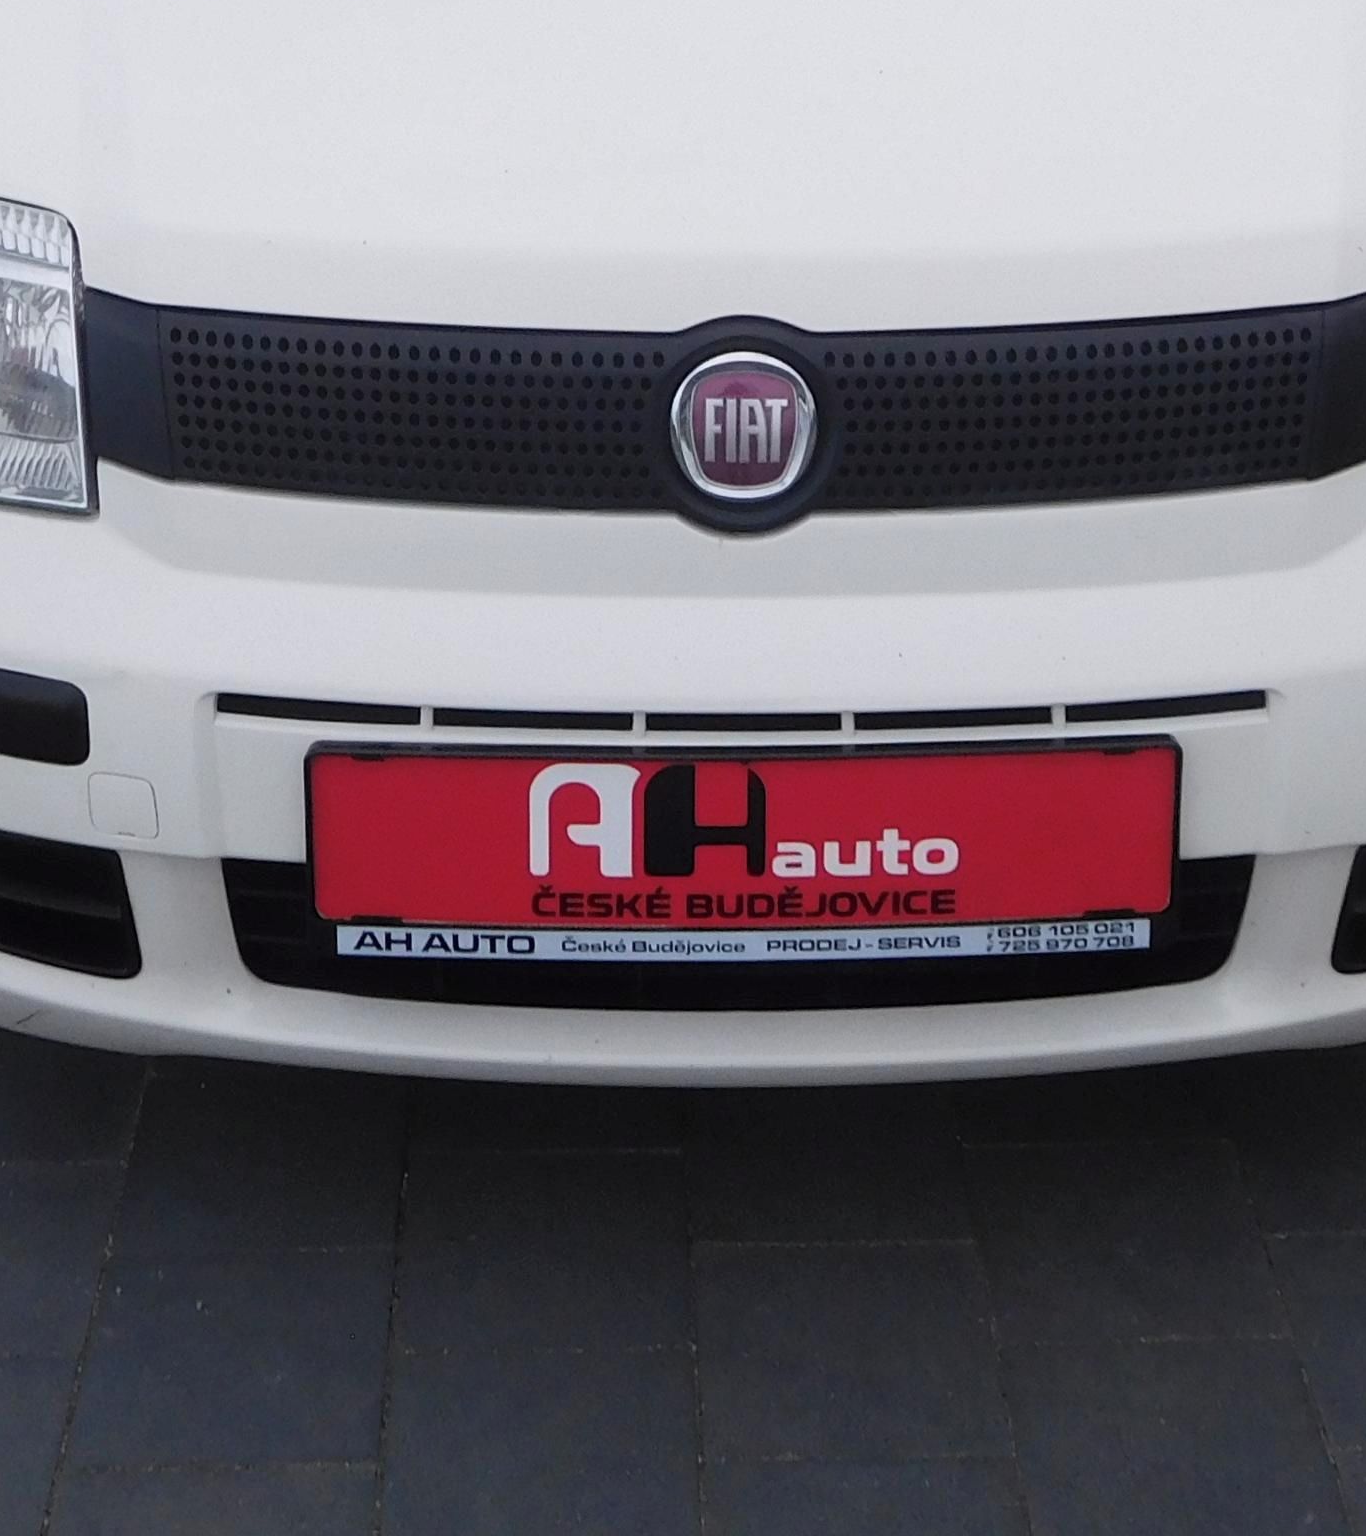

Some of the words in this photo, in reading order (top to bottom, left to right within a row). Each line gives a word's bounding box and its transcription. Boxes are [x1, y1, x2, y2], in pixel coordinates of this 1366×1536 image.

[704, 397, 788, 464] FIAT
[532, 885, 672, 918] ČESKÉ
[686, 885, 956, 918] BUDĚJOVICE
[354, 930, 412, 952] AH
[422, 933, 536, 954] AUTO
[561, 935, 627, 953] České
[631, 939, 746, 956] Budějovice
